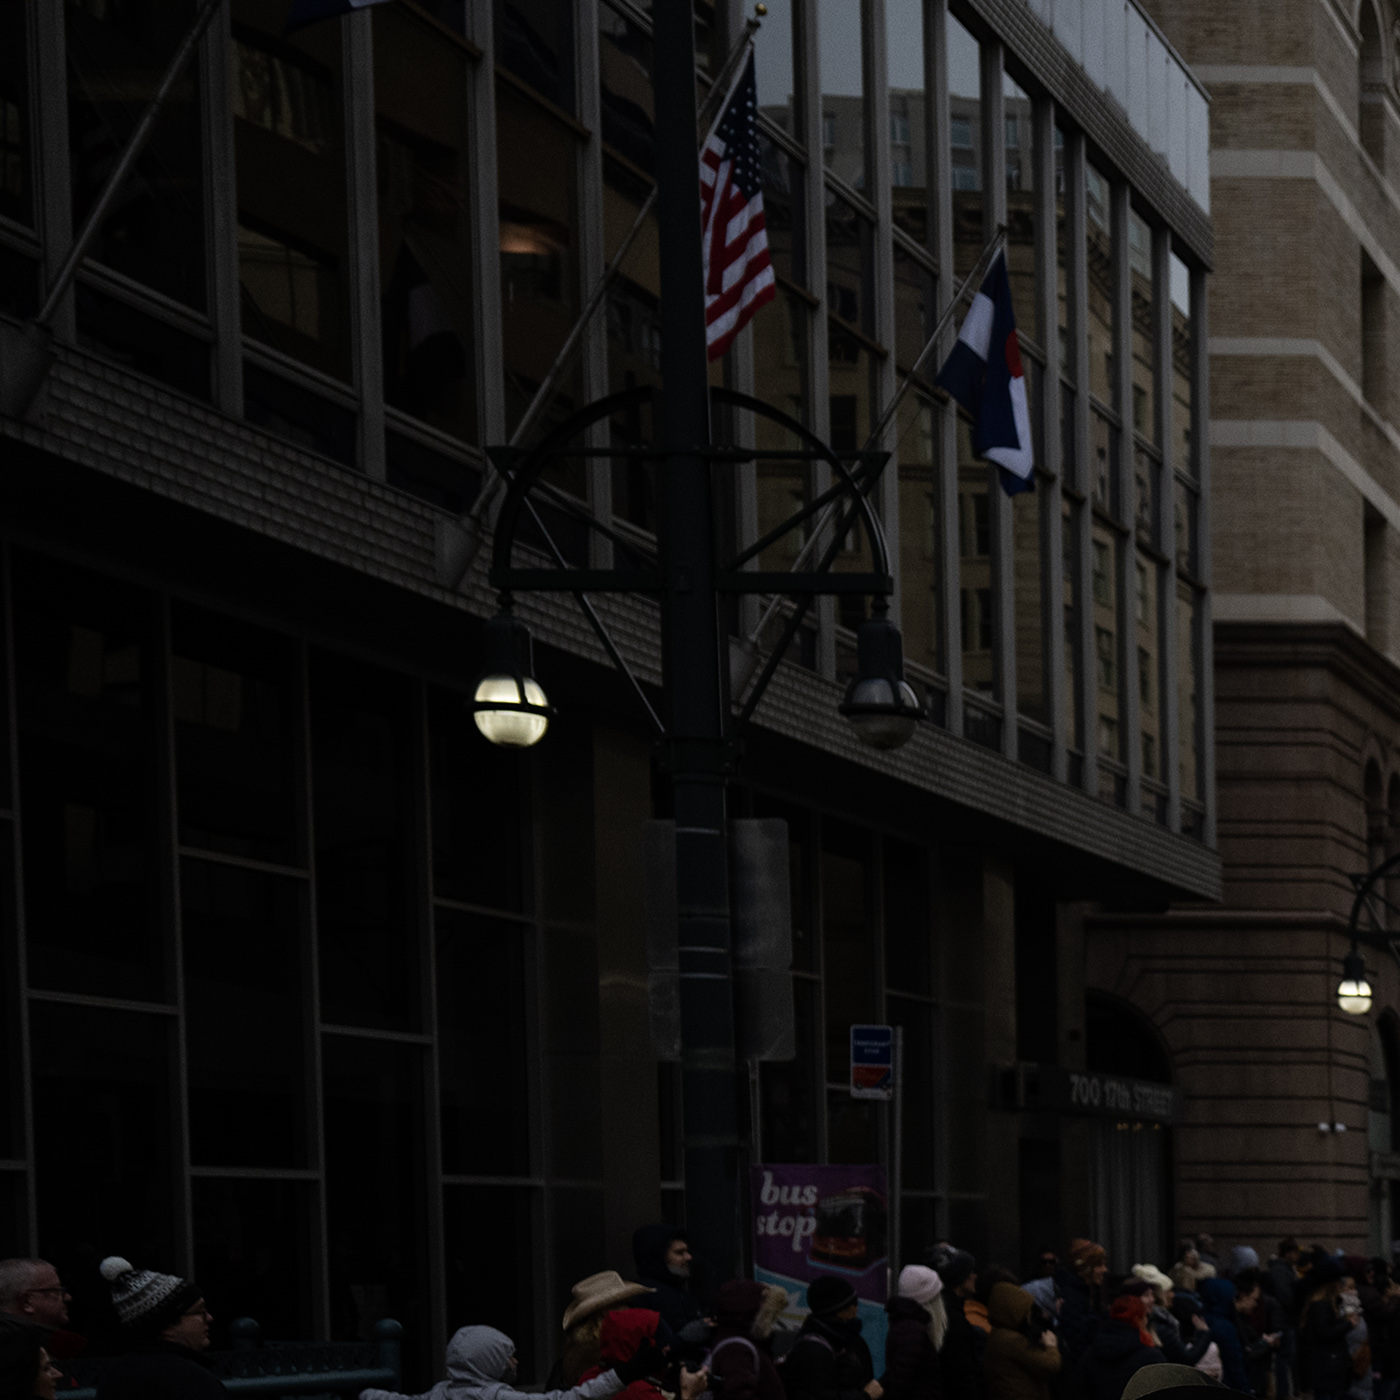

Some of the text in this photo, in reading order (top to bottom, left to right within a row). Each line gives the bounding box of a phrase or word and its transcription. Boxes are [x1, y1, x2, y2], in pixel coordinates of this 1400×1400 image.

[1069, 1074, 1101, 1106] 700
[760, 1170, 818, 1206] bus
[756, 1209, 817, 1252] stop
